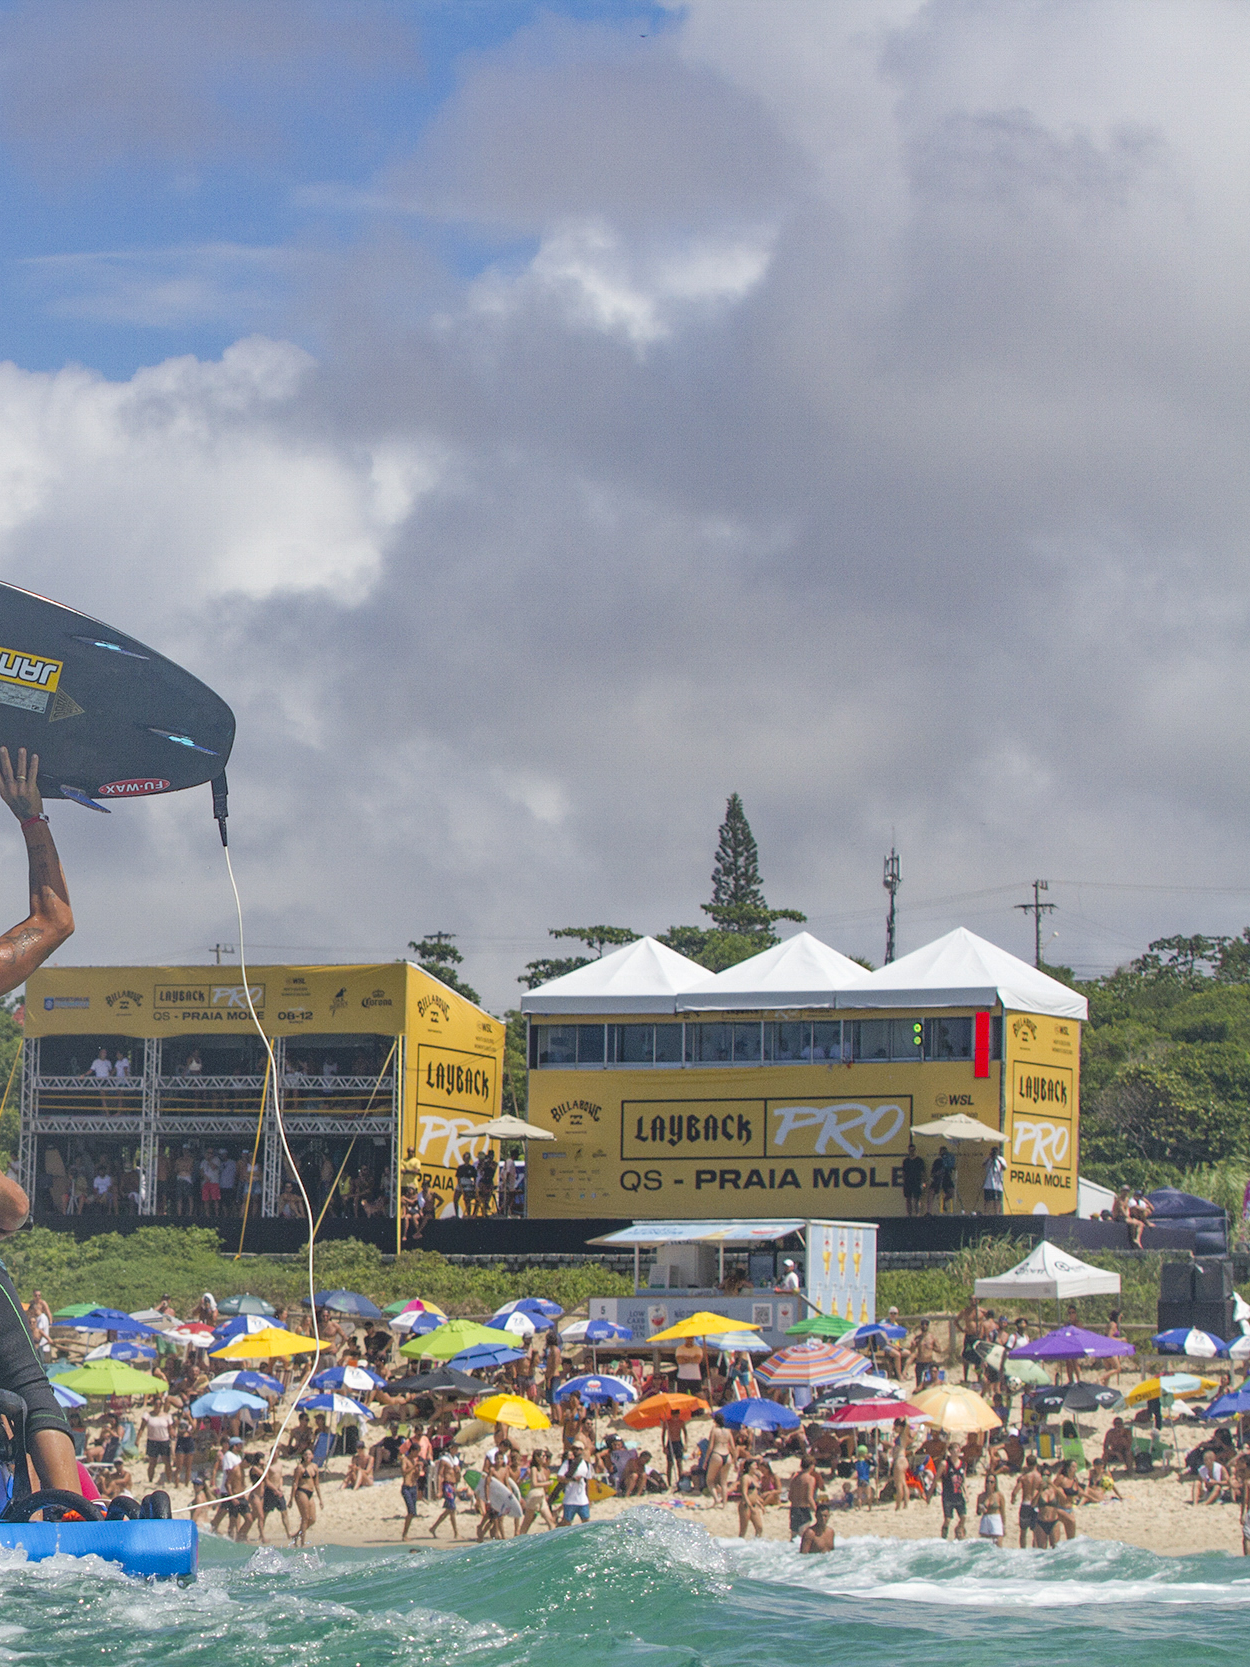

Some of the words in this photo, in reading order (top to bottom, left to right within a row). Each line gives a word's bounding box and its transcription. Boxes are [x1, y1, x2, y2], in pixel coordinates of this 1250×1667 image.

[106, 990, 144, 1008] BILLABONG
[159, 989, 205, 1003] LAYBACK
[212, 987, 262, 1009] PRO
[362, 997, 392, 1008] Corona
[417, 994, 450, 1022] BILLABONG
[153, 1012, 171, 1022] QS
[182, 1011, 223, 1021] PRAIA
[227, 1011, 265, 1021] MOLE
[278, 1011, 313, 1020] 08-12
[426, 1061, 489, 1102] LAYBACK
[1019, 1075, 1067, 1108] LAYBACK
[551, 1100, 602, 1122] BILLABONG
[949, 1094, 974, 1106] WSL
[634, 1113, 752, 1147] LAYBACK
[773, 1103, 905, 1160] PRO
[1013, 1121, 1069, 1173] PRO
[620, 1170, 663, 1192] QS
[695, 1169, 802, 1190] PRAIA
[812, 1166, 905, 1189] MOLE
[1010, 1170, 1042, 1186] PRAIA
[1045, 1174, 1071, 1189] MOLE
